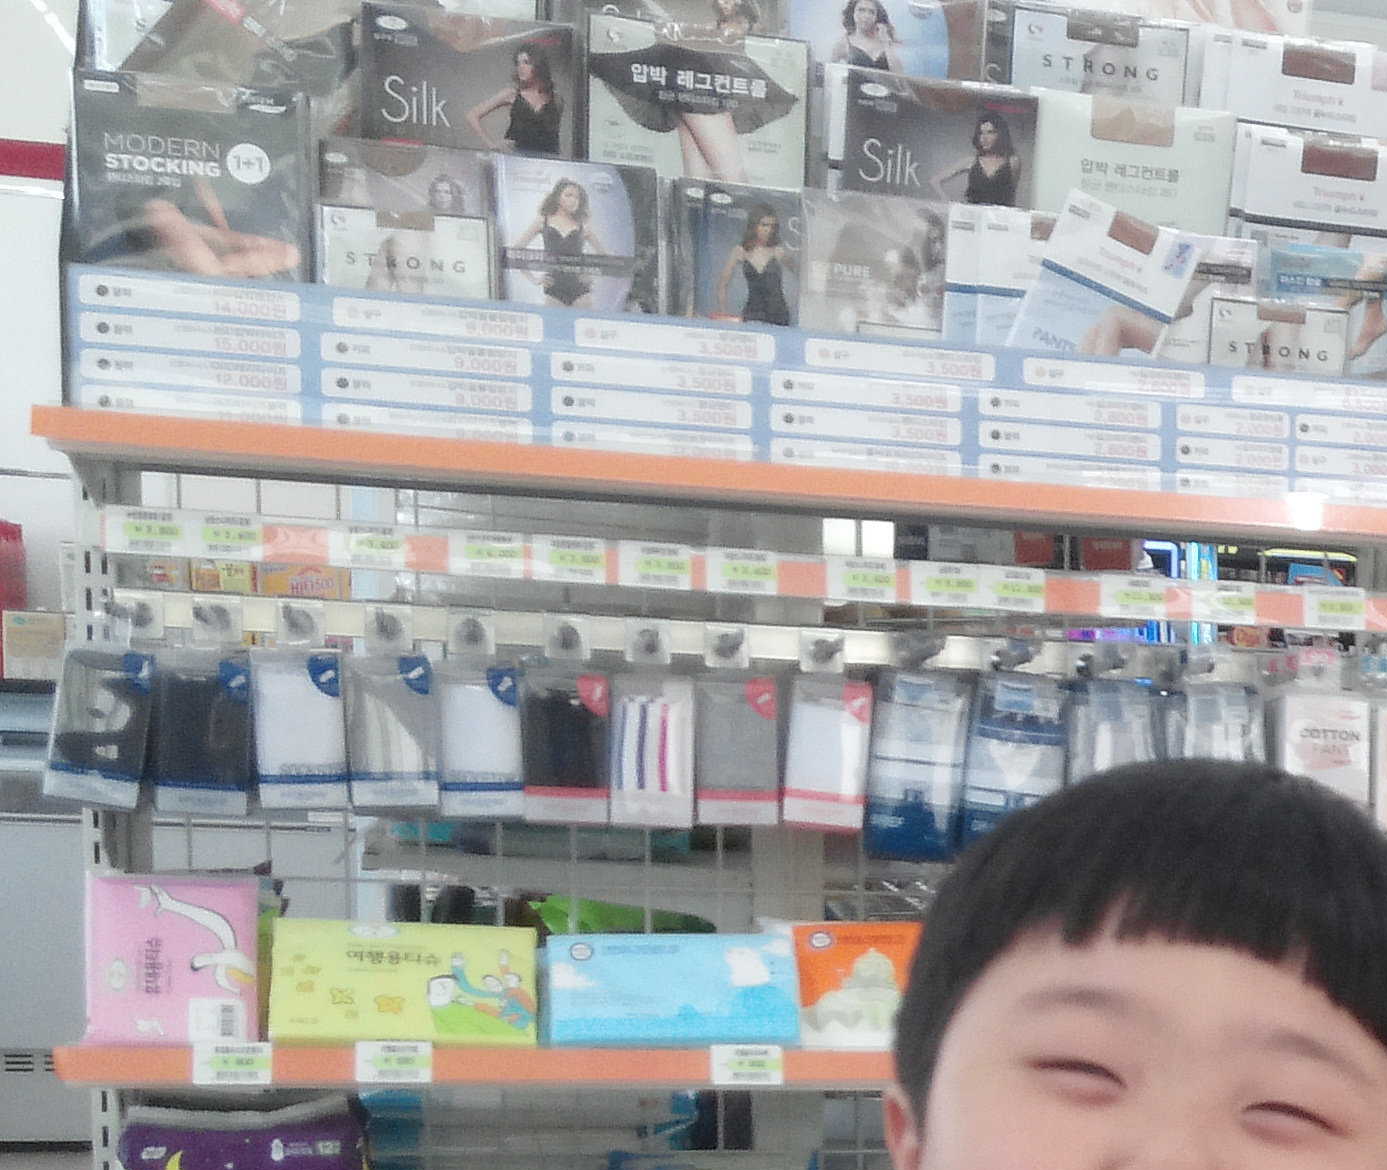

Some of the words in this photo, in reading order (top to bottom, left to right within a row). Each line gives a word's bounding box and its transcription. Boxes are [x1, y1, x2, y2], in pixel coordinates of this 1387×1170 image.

[631, 63, 667, 86] 압박
[676, 69, 767, 98] 레그컨트롤
[1041, 54, 1160, 82] STRONG
[381, 75, 450, 127] Silk
[104, 133, 220, 158] MODERN
[105, 153, 221, 177] STOCKING
[859, 138, 921, 188] Silk
[345, 250, 470, 276] STRONG
[1229, 341, 1328, 363] STRONG
[1299, 727, 1360, 743] COTTON
[346, 947, 440, 968] 여행용티슈
